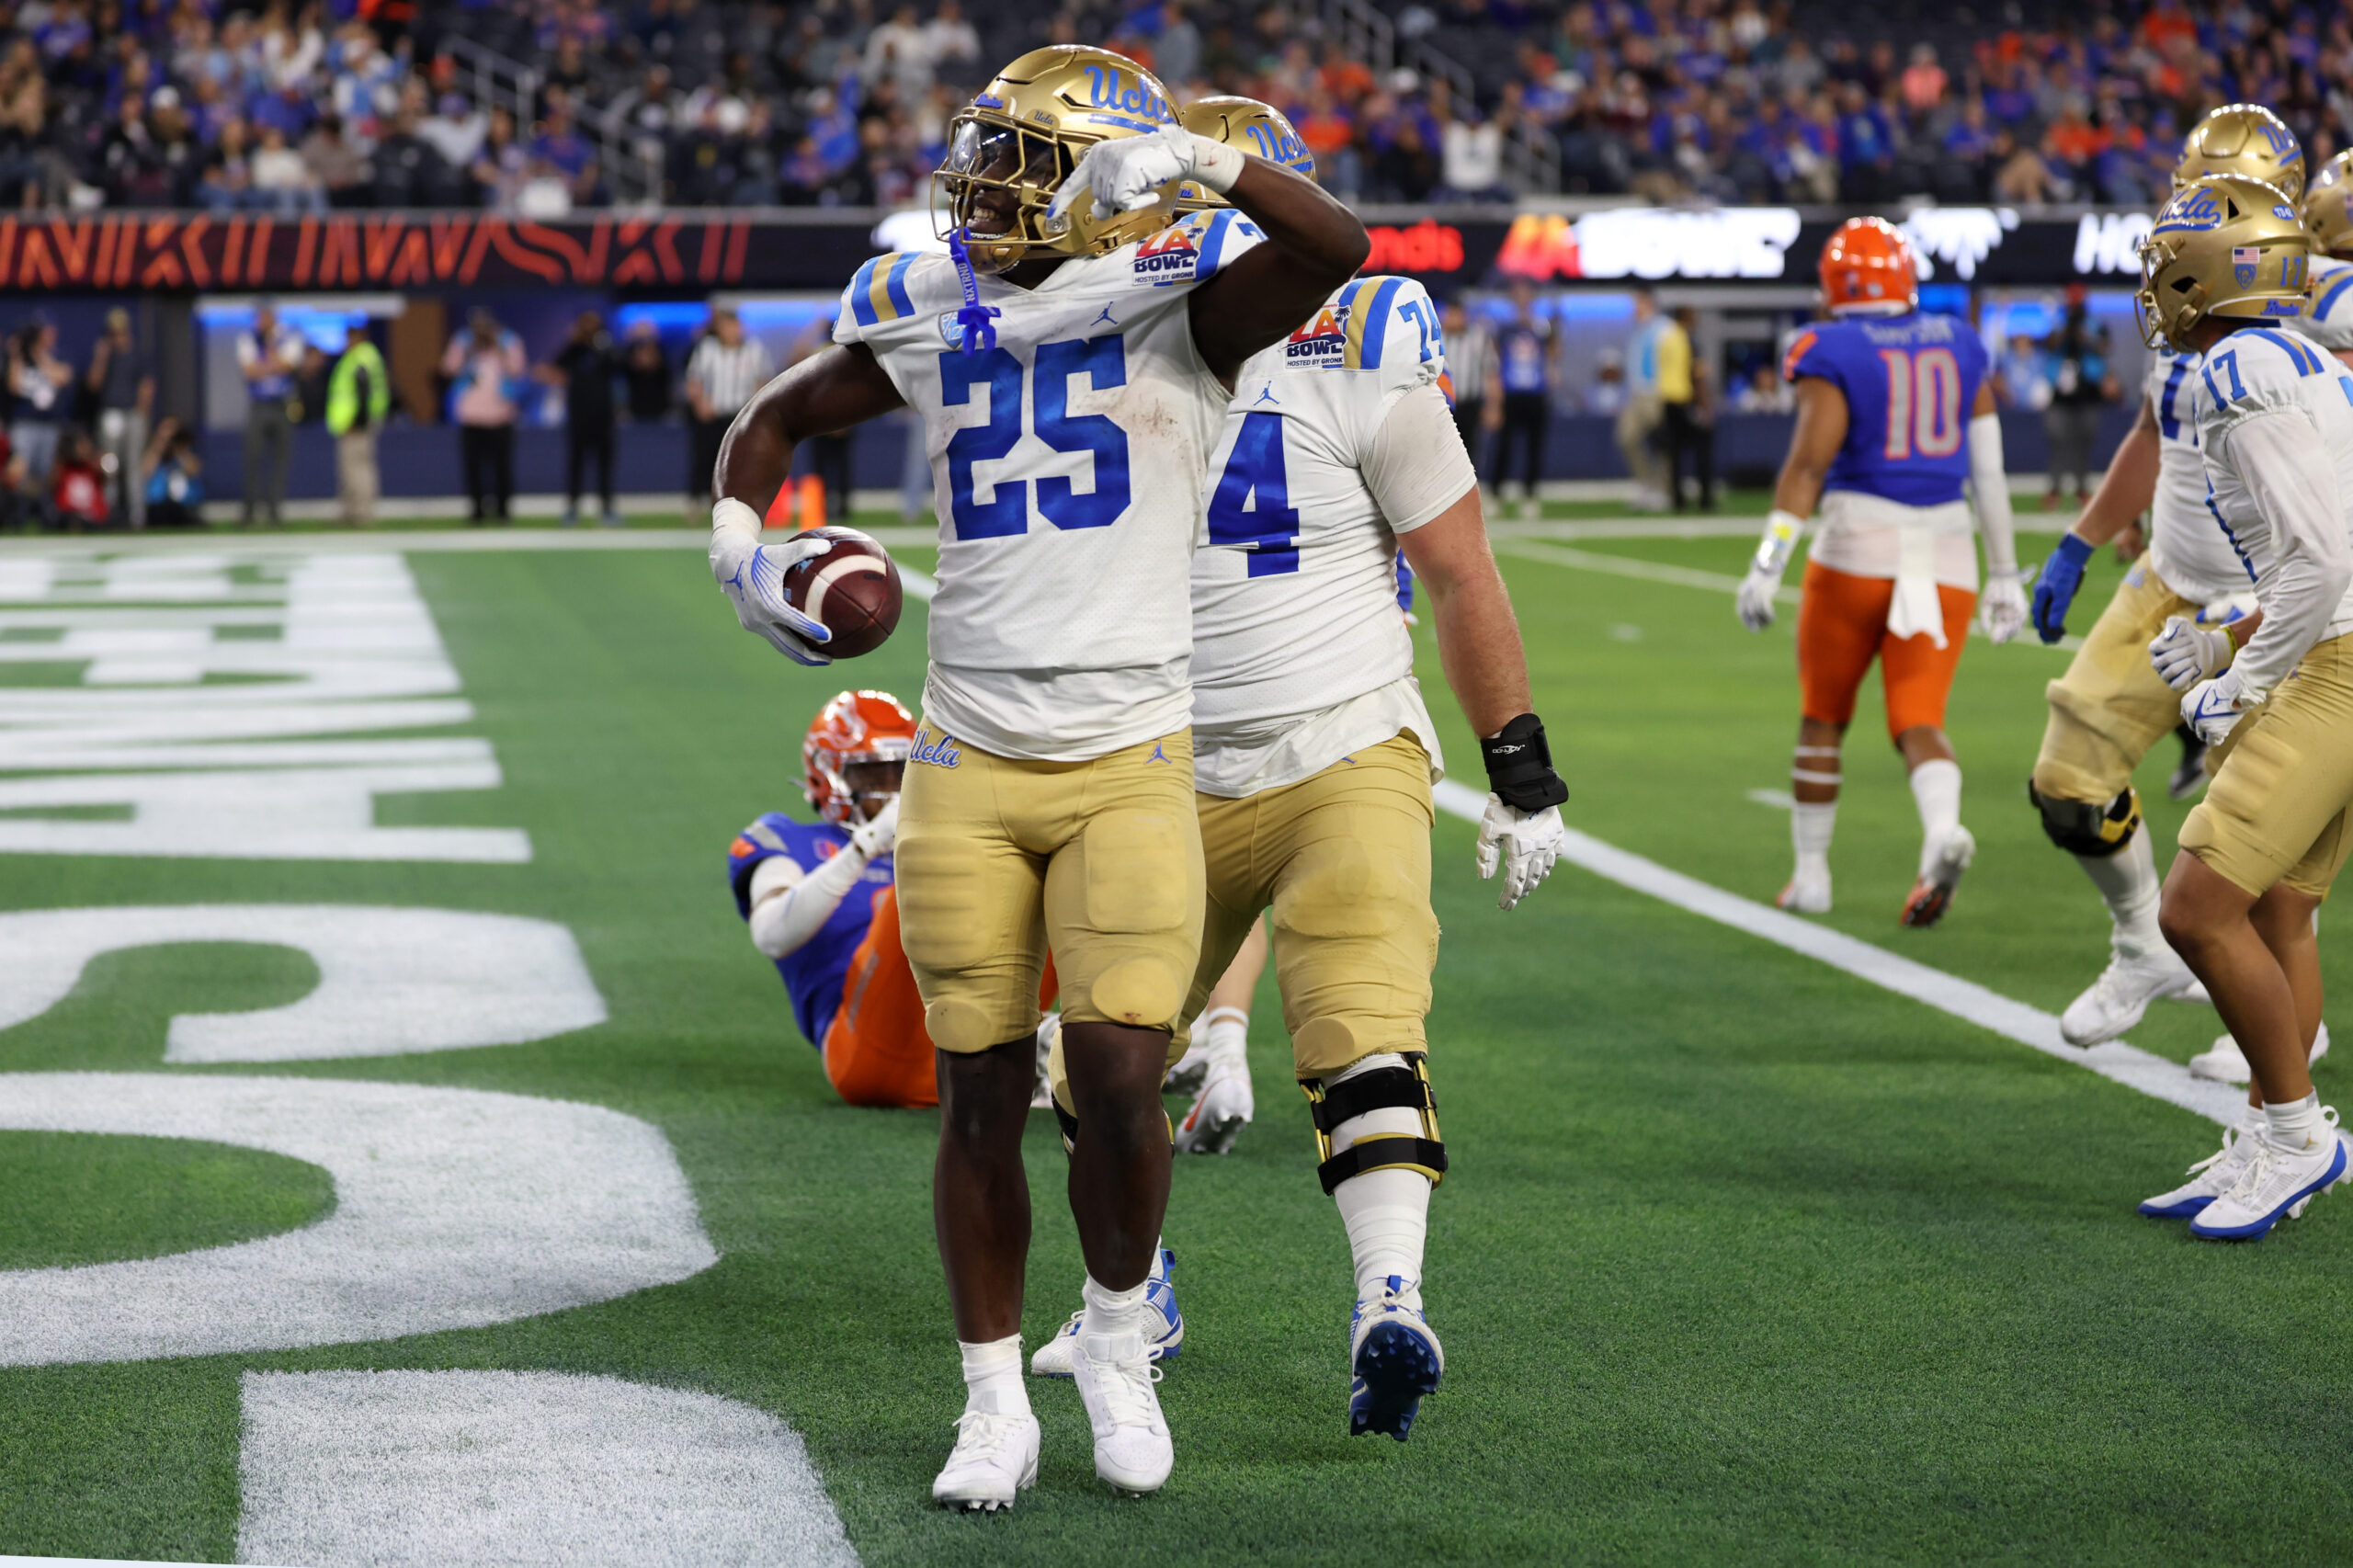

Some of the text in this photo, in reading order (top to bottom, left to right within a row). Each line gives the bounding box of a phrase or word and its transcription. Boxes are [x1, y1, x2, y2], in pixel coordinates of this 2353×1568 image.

[1136, 229, 1194, 257] LA
[1134, 255, 1194, 273] BOWL
[1134, 275, 1160, 284] HOSTED
[1171, 271, 1195, 280] GRONK
[2279, 256, 2302, 286] 17
[958, 262, 976, 302] NXTRND
[1289, 309, 1342, 342] LA
[1287, 339, 1343, 358] BOWL
[1287, 357, 1343, 367] HOSTED BY GRONK
[2201, 348, 2247, 413] 17
[1878, 347, 1962, 460] 10
[938, 333, 1131, 541] 25
[1208, 411, 1301, 579] 4
[909, 729, 960, 767] Ucla
